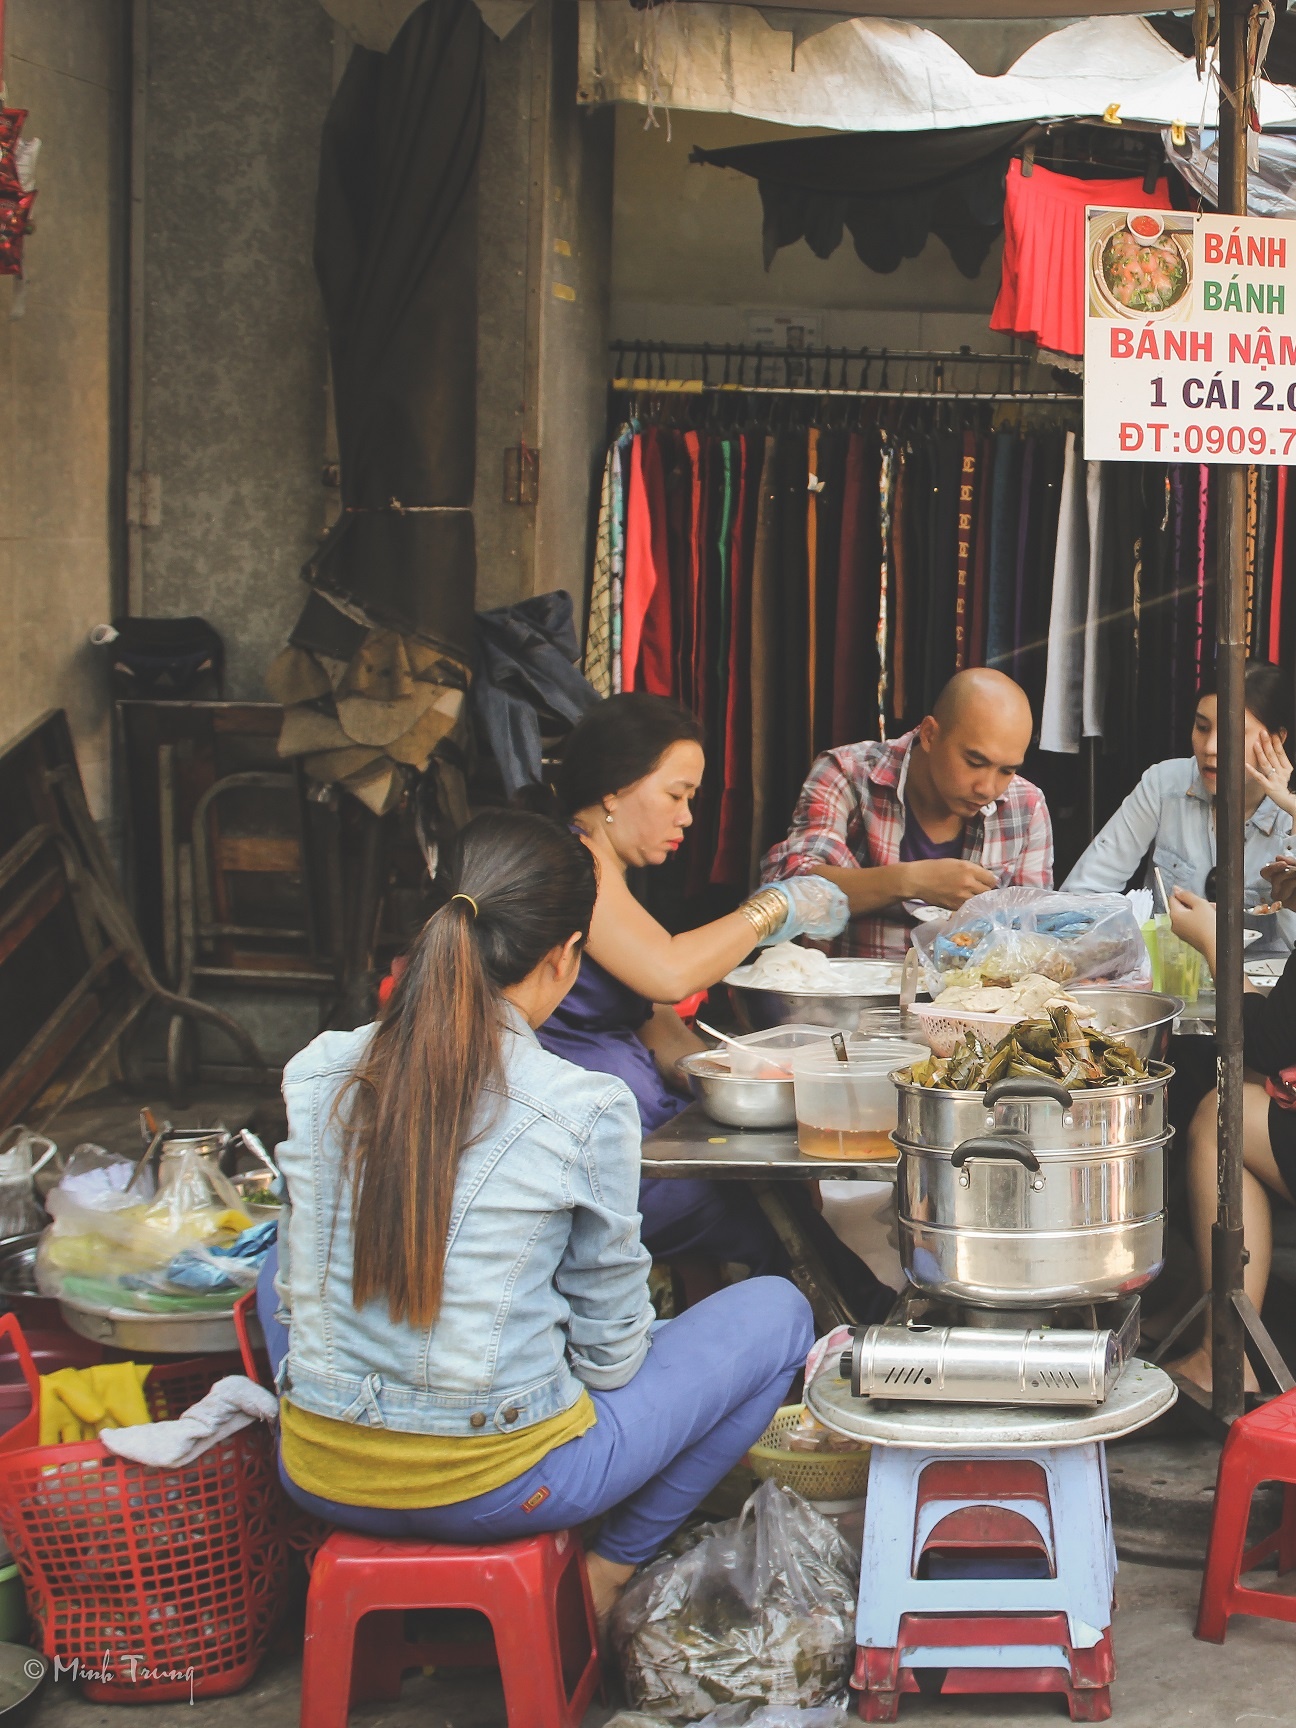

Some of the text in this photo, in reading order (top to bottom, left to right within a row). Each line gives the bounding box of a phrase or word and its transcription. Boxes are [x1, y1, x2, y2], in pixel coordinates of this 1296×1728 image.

[1204, 226, 1287, 269] BÁNH
[1203, 273, 1285, 315] BÁNH
[1110, 320, 1213, 363] BÁNH
[1150, 377, 1167, 407] 1
[1182, 371, 1240, 411] CÁI
